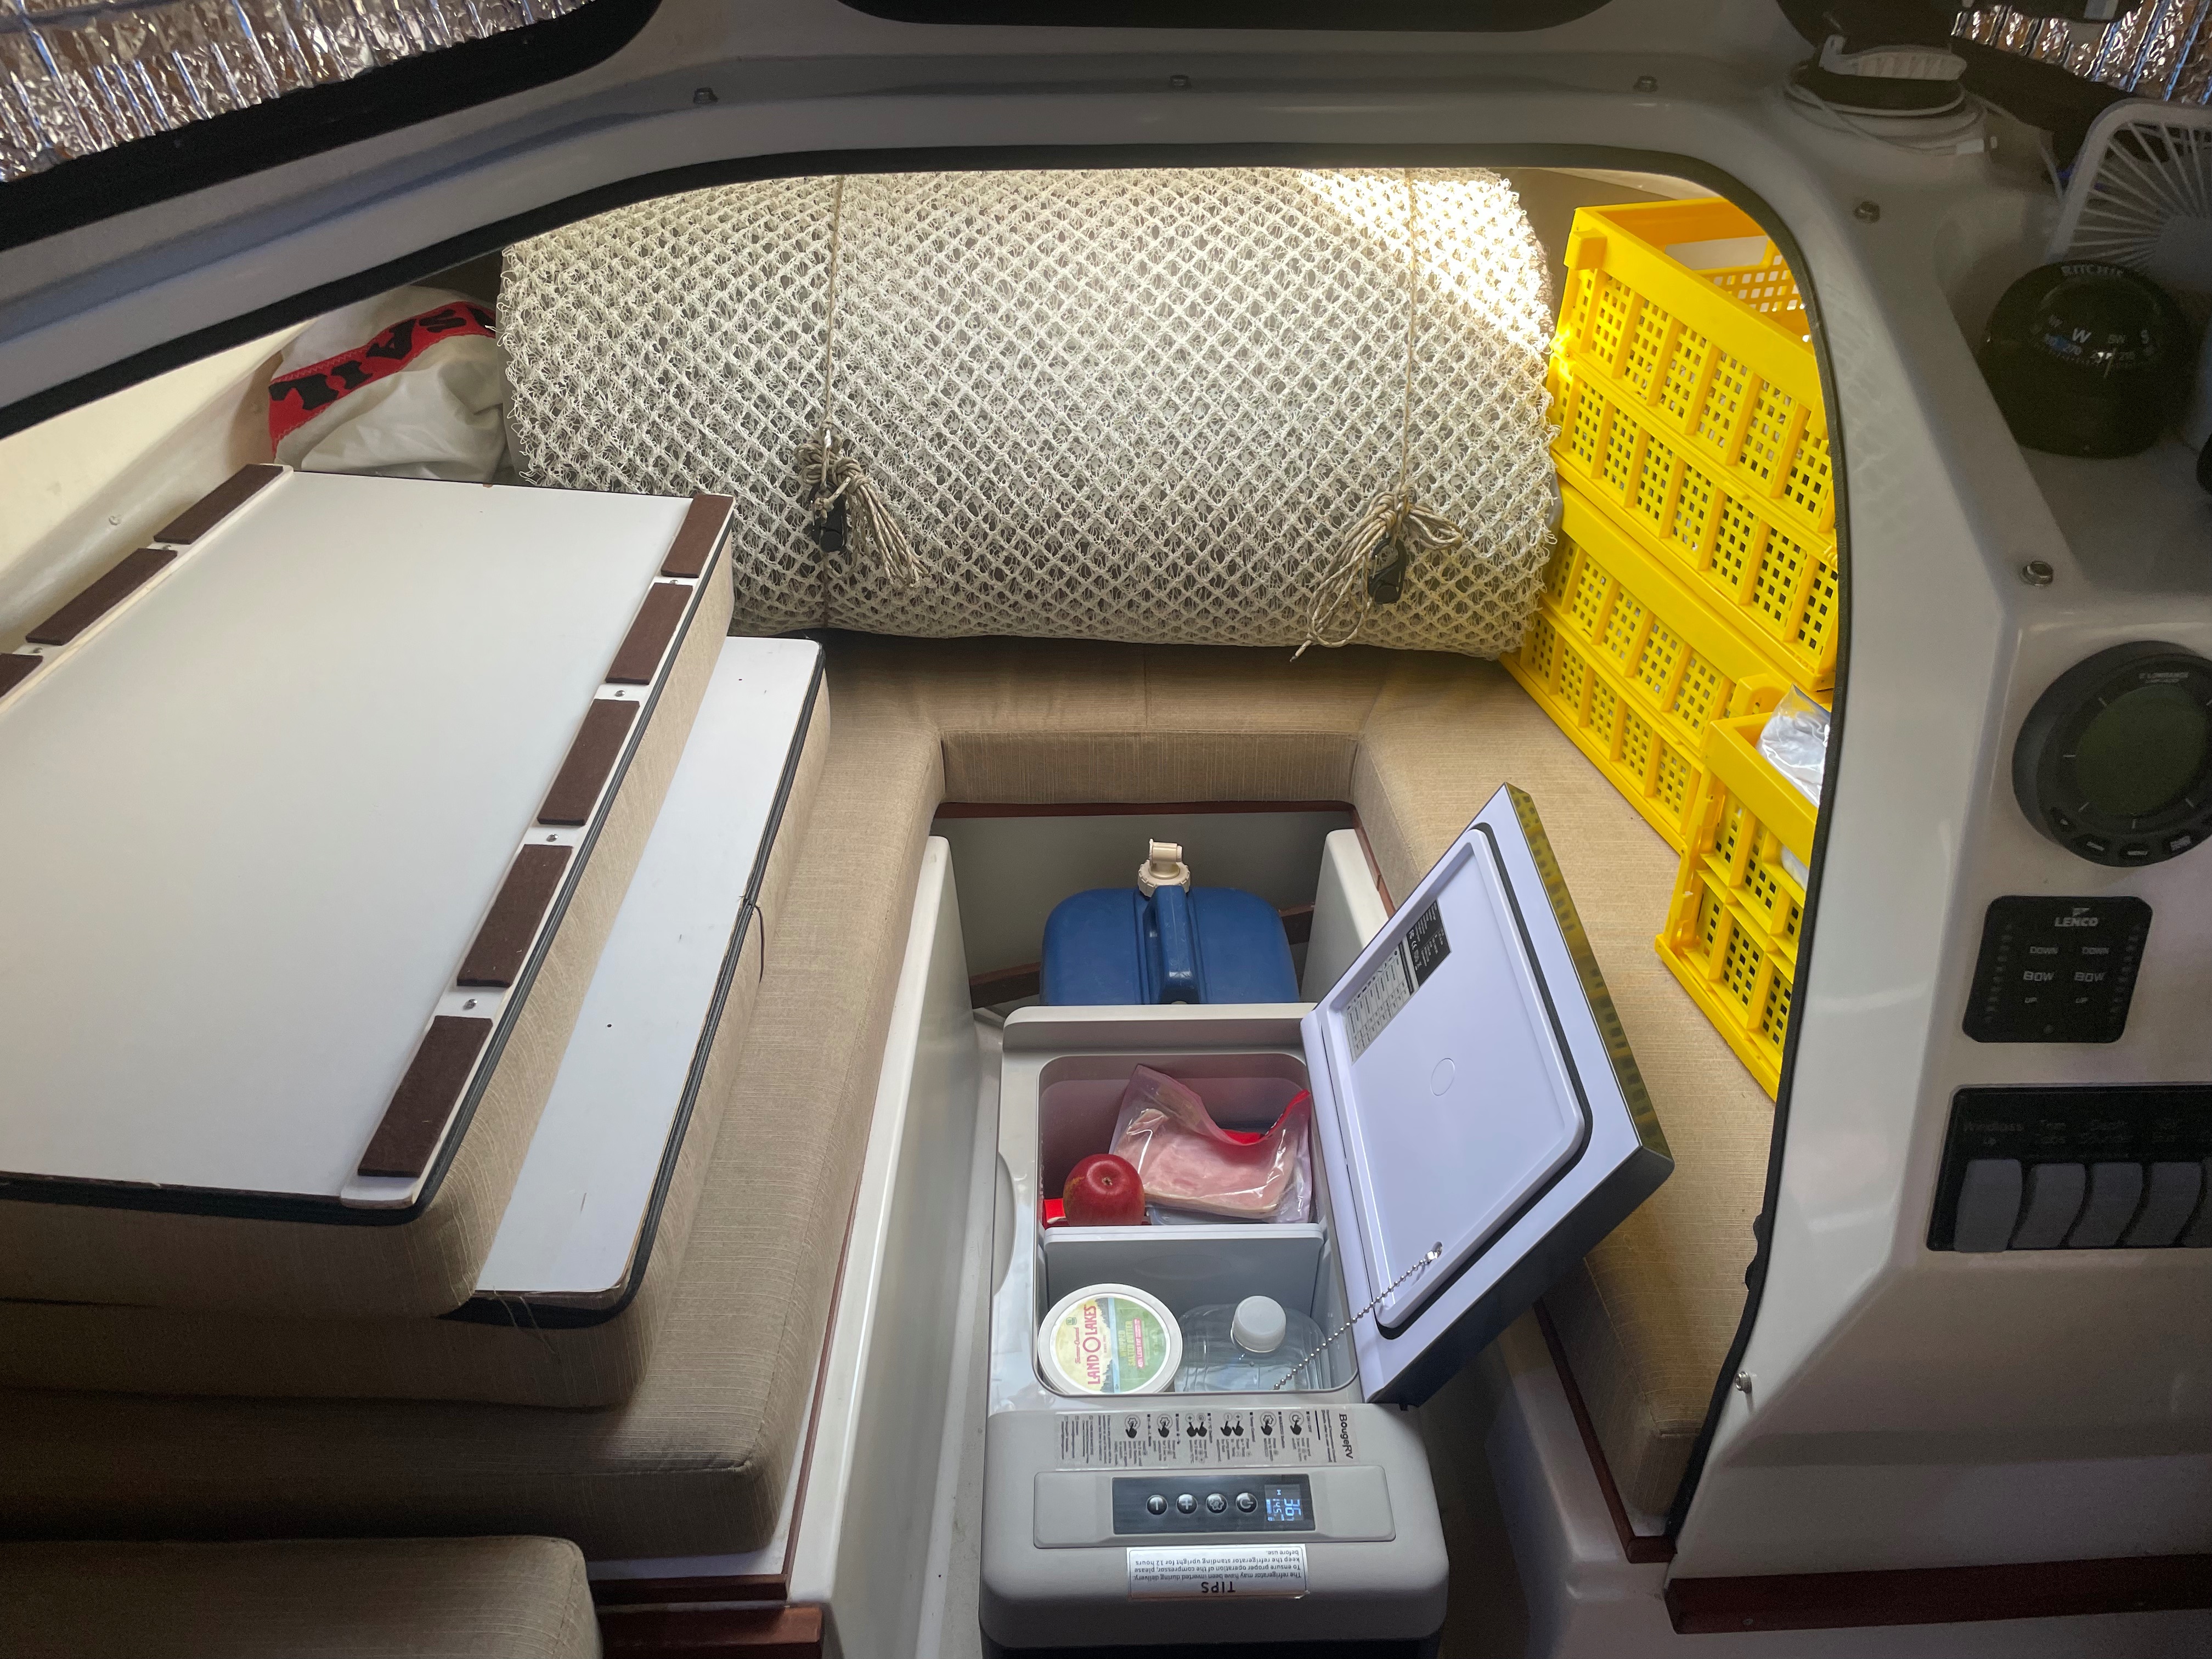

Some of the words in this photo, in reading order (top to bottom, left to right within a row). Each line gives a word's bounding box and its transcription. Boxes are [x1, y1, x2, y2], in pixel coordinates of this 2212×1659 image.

[2072, 328, 2092, 343] W
[2055, 917, 2098, 927] LENCO
[2029, 946, 2059, 955] DOWN
[2082, 946, 2109, 955] DOWN
[2023, 971, 2055, 982] BOW
[2074, 972, 2107, 982] BOW
[1084, 1305, 1098, 1335] LAKES
[1125, 1321, 1133, 1343] BUTTER
[1082, 1337, 1101, 1353] O
[1119, 1330, 1127, 1357] WHIPPED
[1127, 1344, 1136, 1366] SALTED
[1086, 1355, 1101, 1385] LAND
[1339, 1413, 1353, 1459] BougeRV
[1284, 1498, 1301, 1516] 36
[1200, 1582, 1235, 1593] TIPS
